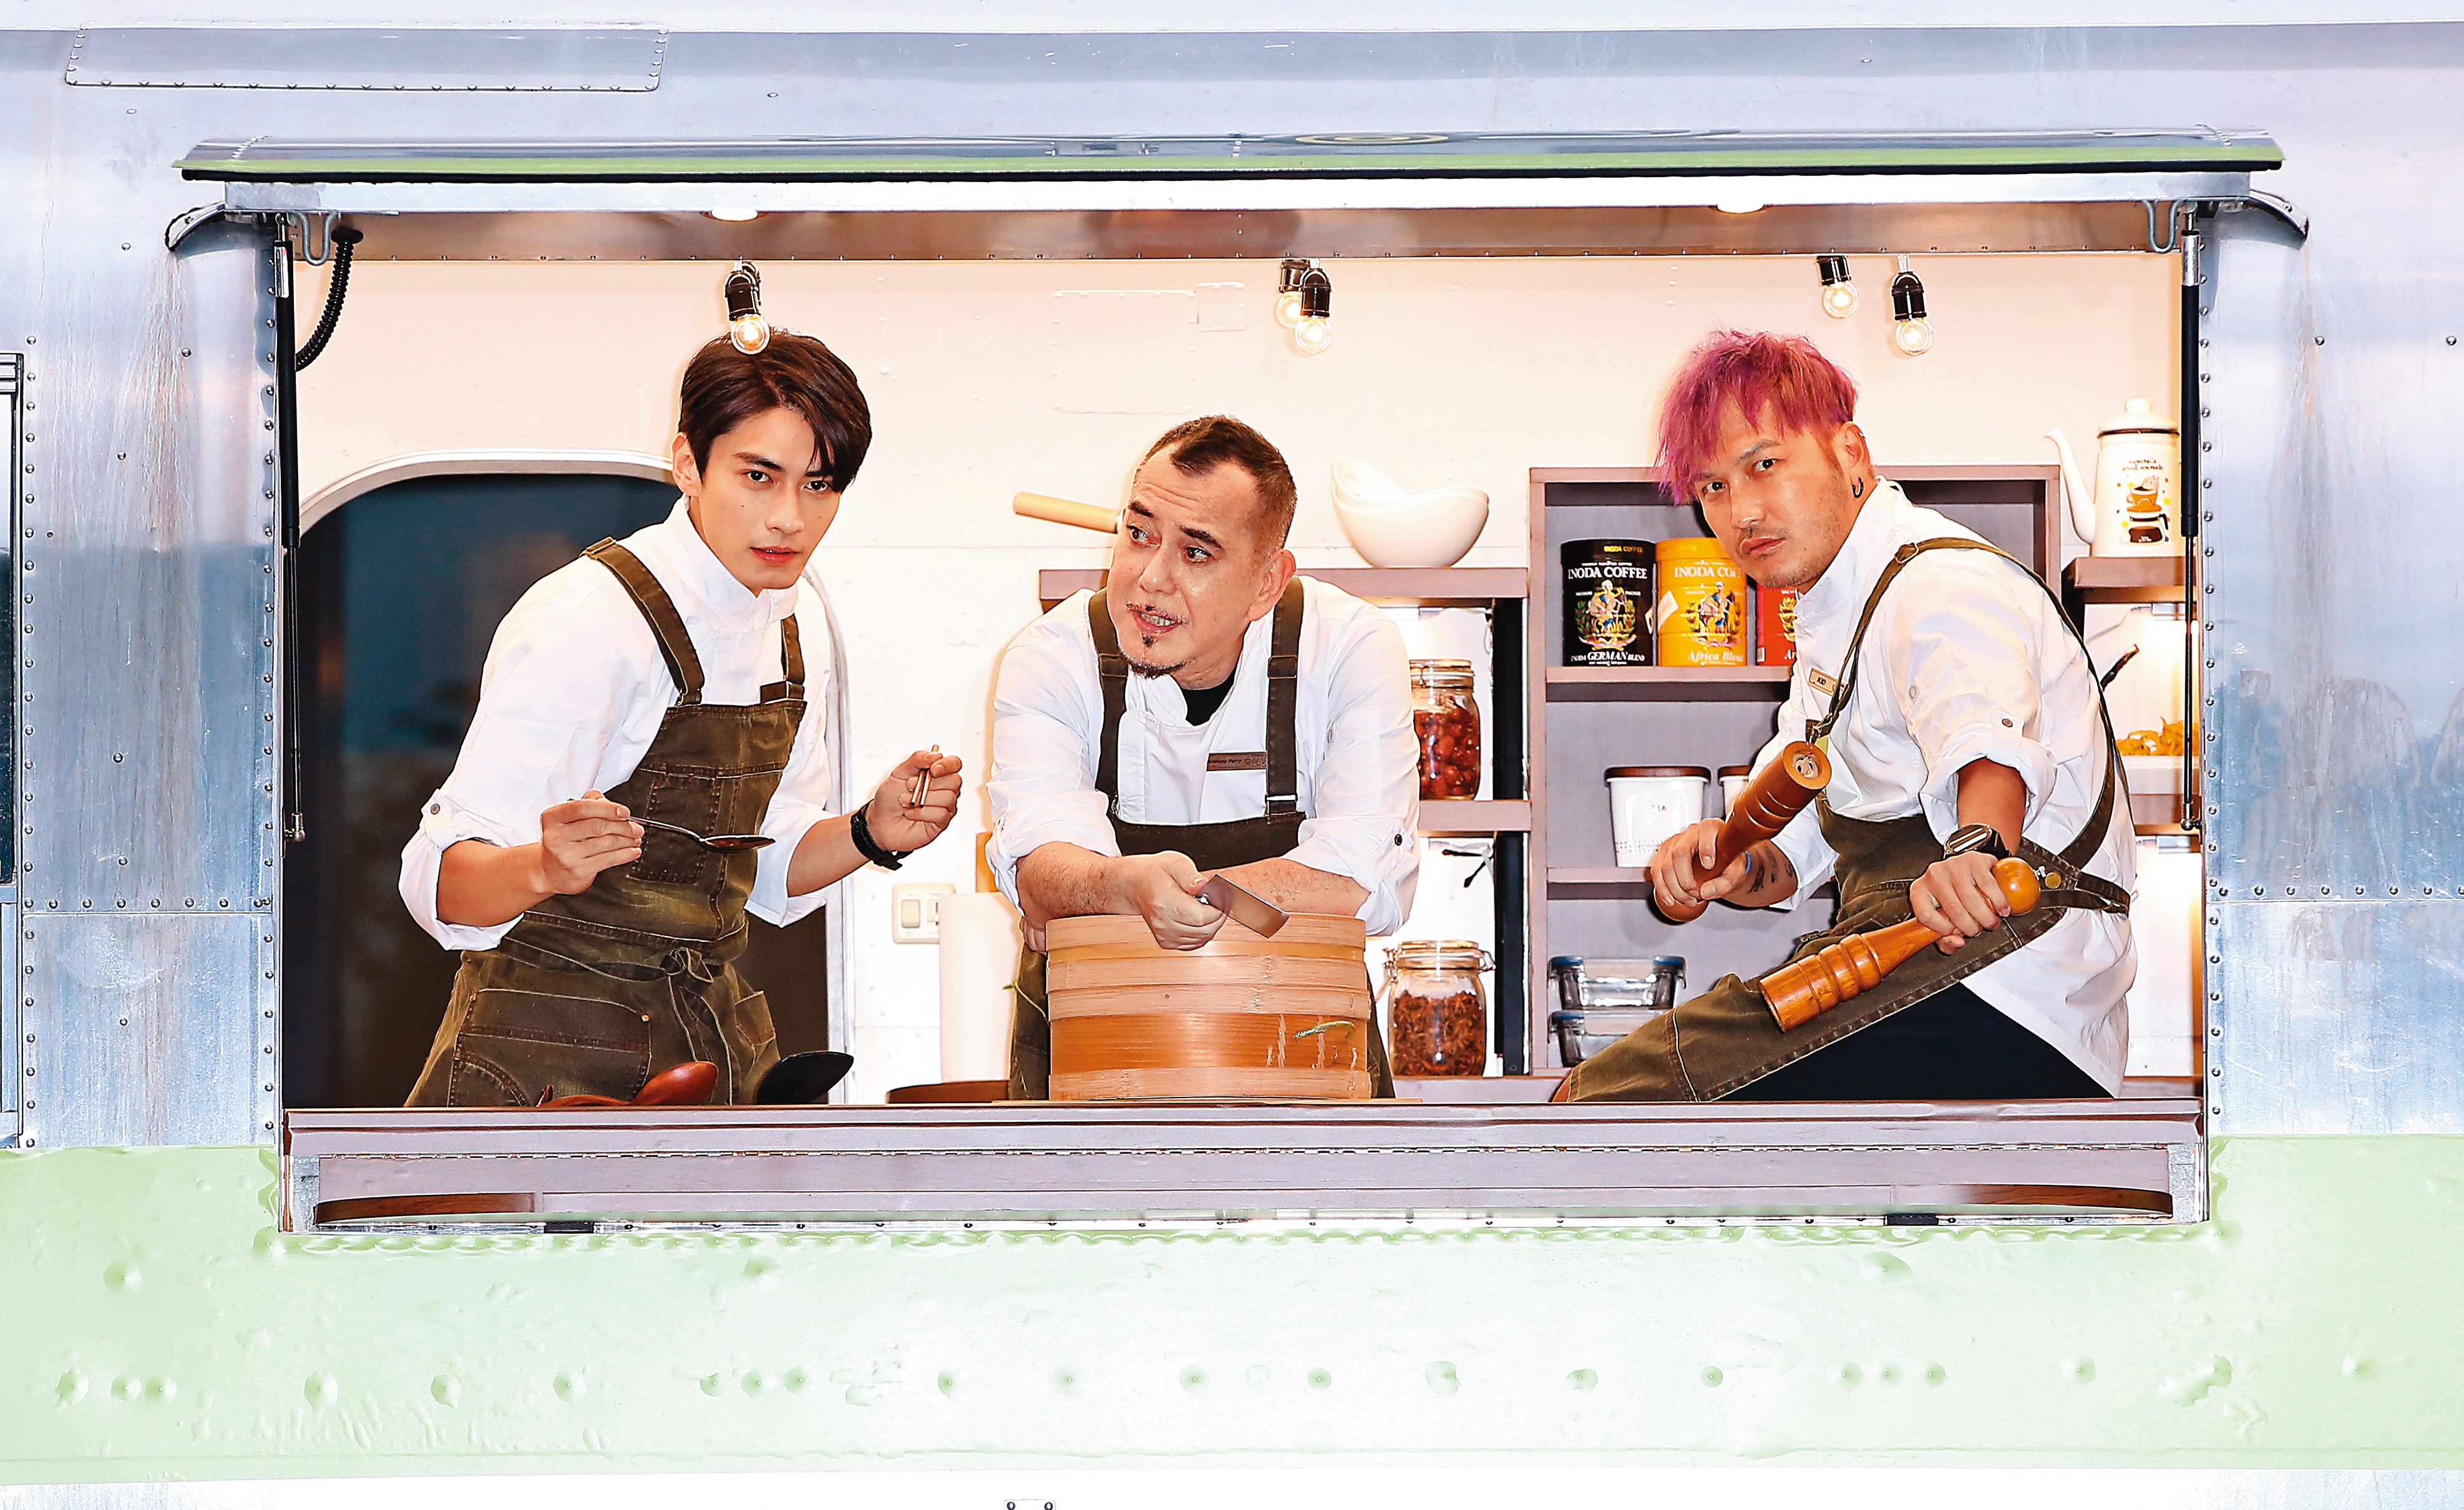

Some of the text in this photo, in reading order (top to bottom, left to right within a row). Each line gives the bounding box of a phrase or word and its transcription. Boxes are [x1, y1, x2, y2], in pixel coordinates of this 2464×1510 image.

[1567, 566, 1648, 580] INODA COFFEE
[1674, 566, 1715, 578] INODA
[1587, 651, 1627, 661] GERMAN
[1687, 650, 1720, 663] Africa
